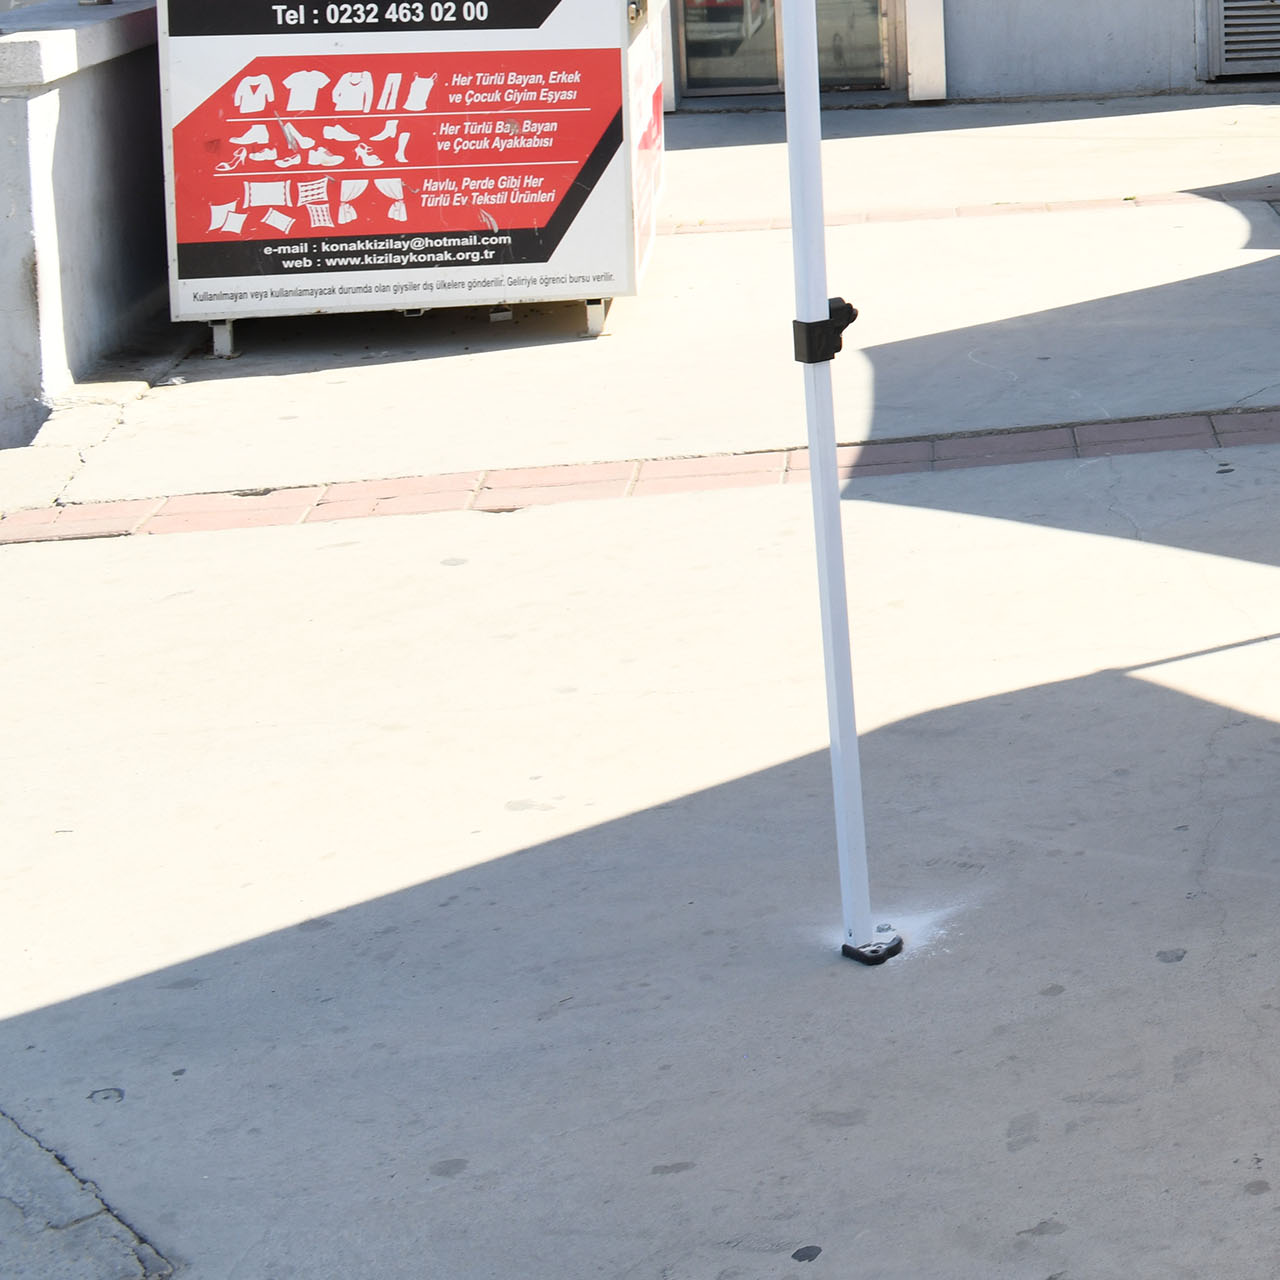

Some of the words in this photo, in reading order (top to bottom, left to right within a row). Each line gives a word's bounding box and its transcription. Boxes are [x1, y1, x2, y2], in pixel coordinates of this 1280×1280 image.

[273, 4, 305, 25] Tel
[326, 4, 379, 24] 0232
[384, 3, 425, 23] 463
[430, 2, 457, 22] 02
[462, 1, 489, 21] 00
[451, 74, 472, 86] Her
[475, 73, 504, 85] Türlü
[507, 72, 545, 87] Bayan,
[548, 71, 581, 84] Erkek
[449, 94, 462, 103] ve
[465, 90, 501, 105] Çocuk
[504, 89, 537, 104] Giyim
[539, 89, 577, 102] Eşyası
[439, 122, 460, 135] Her
[463, 122, 493, 134] Türlü
[522, 120, 558, 133] Bayan
[437, 142, 451, 151] ve
[453, 138, 489, 153] Çocuk
[491, 136, 553, 151] Ayakkabısı
[423, 178, 458, 192] Havlu,
[462, 177, 495, 190] Perde
[498, 176, 520, 189] Gibi
[523, 176, 544, 188] Her
[421, 194, 450, 208] Türlü
[453, 193, 468, 206] Ev
[471, 191, 507, 205] Tekstil
[510, 189, 556, 204] Ürünleri
[264, 242, 309, 255] e-mail
[321, 234, 512, 253] konakkizilay@hotmail.com
[282, 257, 312, 269] web
[325, 250, 495, 267] www.kizilaykonak.org.tr
[250, 290, 268, 301] veya
[338, 284, 372, 295] durumda
[375, 283, 391, 294] olan
[393, 281, 420, 294] giysiler
[436, 279, 465, 290] ülkelere
[569, 274, 590, 284] bursu
